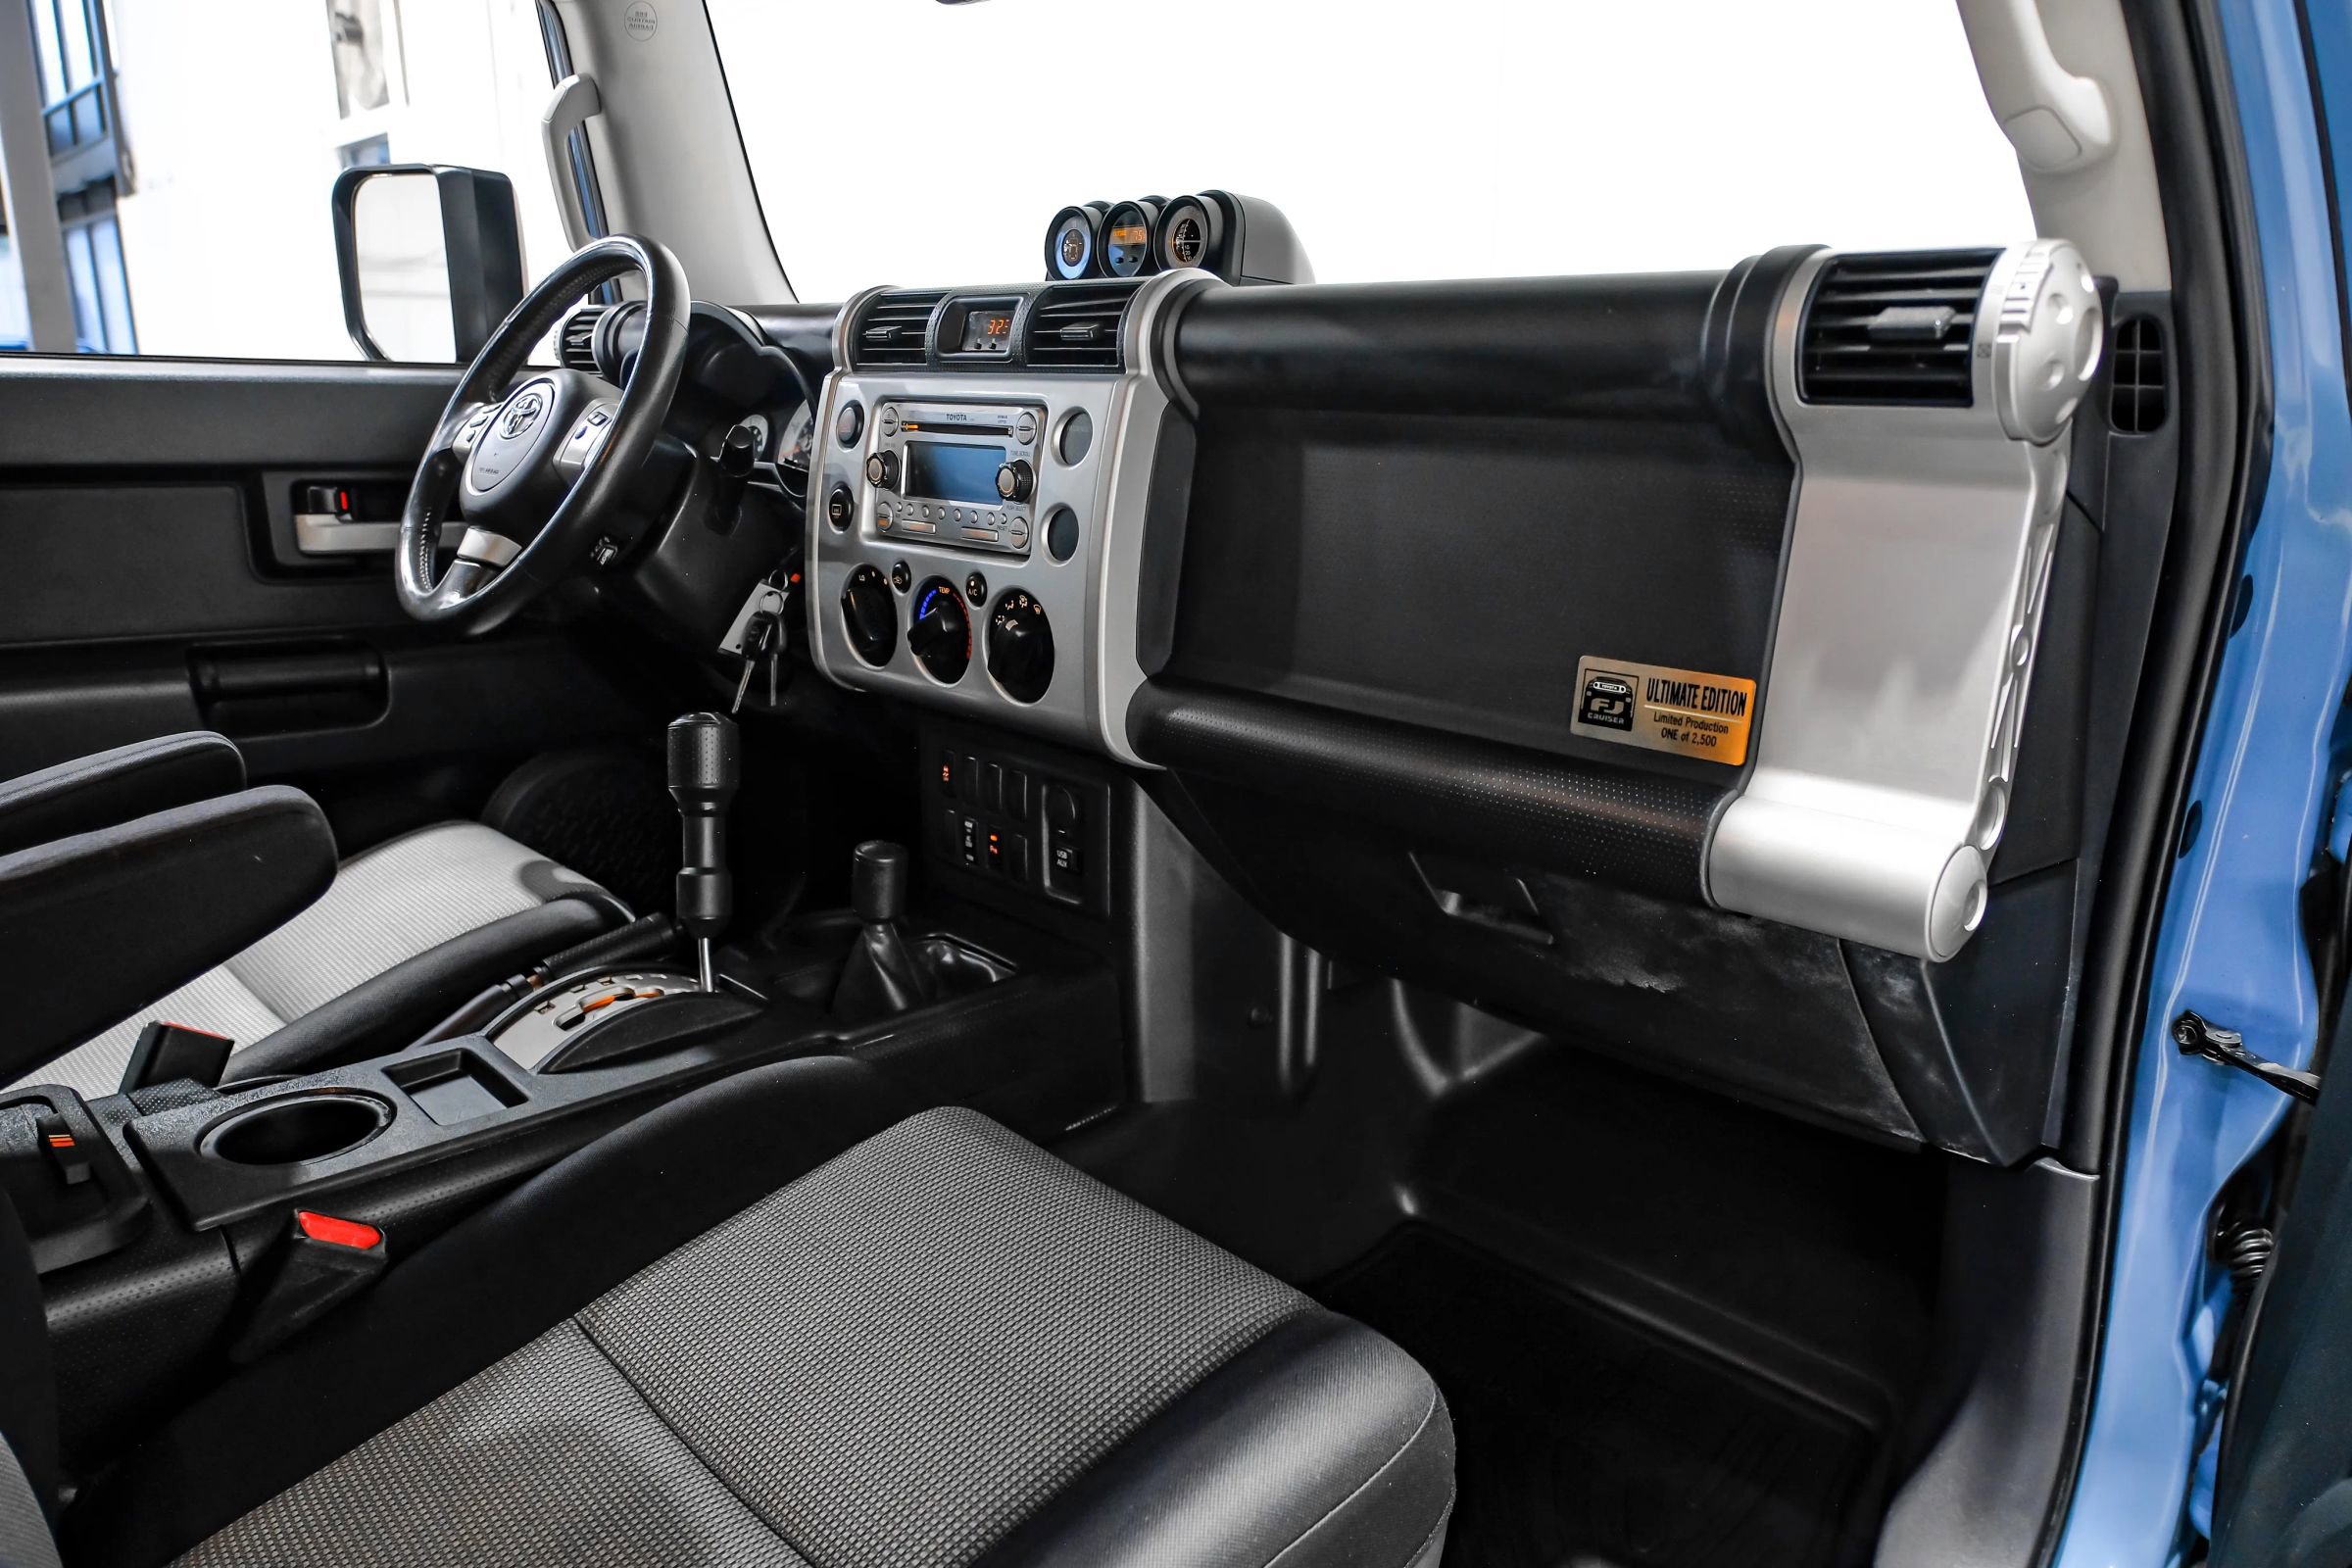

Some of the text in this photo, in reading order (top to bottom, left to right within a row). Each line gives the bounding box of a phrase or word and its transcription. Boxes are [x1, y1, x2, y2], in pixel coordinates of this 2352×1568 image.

[1591, 698, 1625, 714] FJ
[1646, 678, 1747, 716] ULTIMATE EDITION
[1588, 712, 1625, 724] CRUISER
[1654, 711, 1729, 734] Limited Production
[1661, 727, 1717, 747] ONE of 2,500
[1056, 850, 1067, 858] USB
